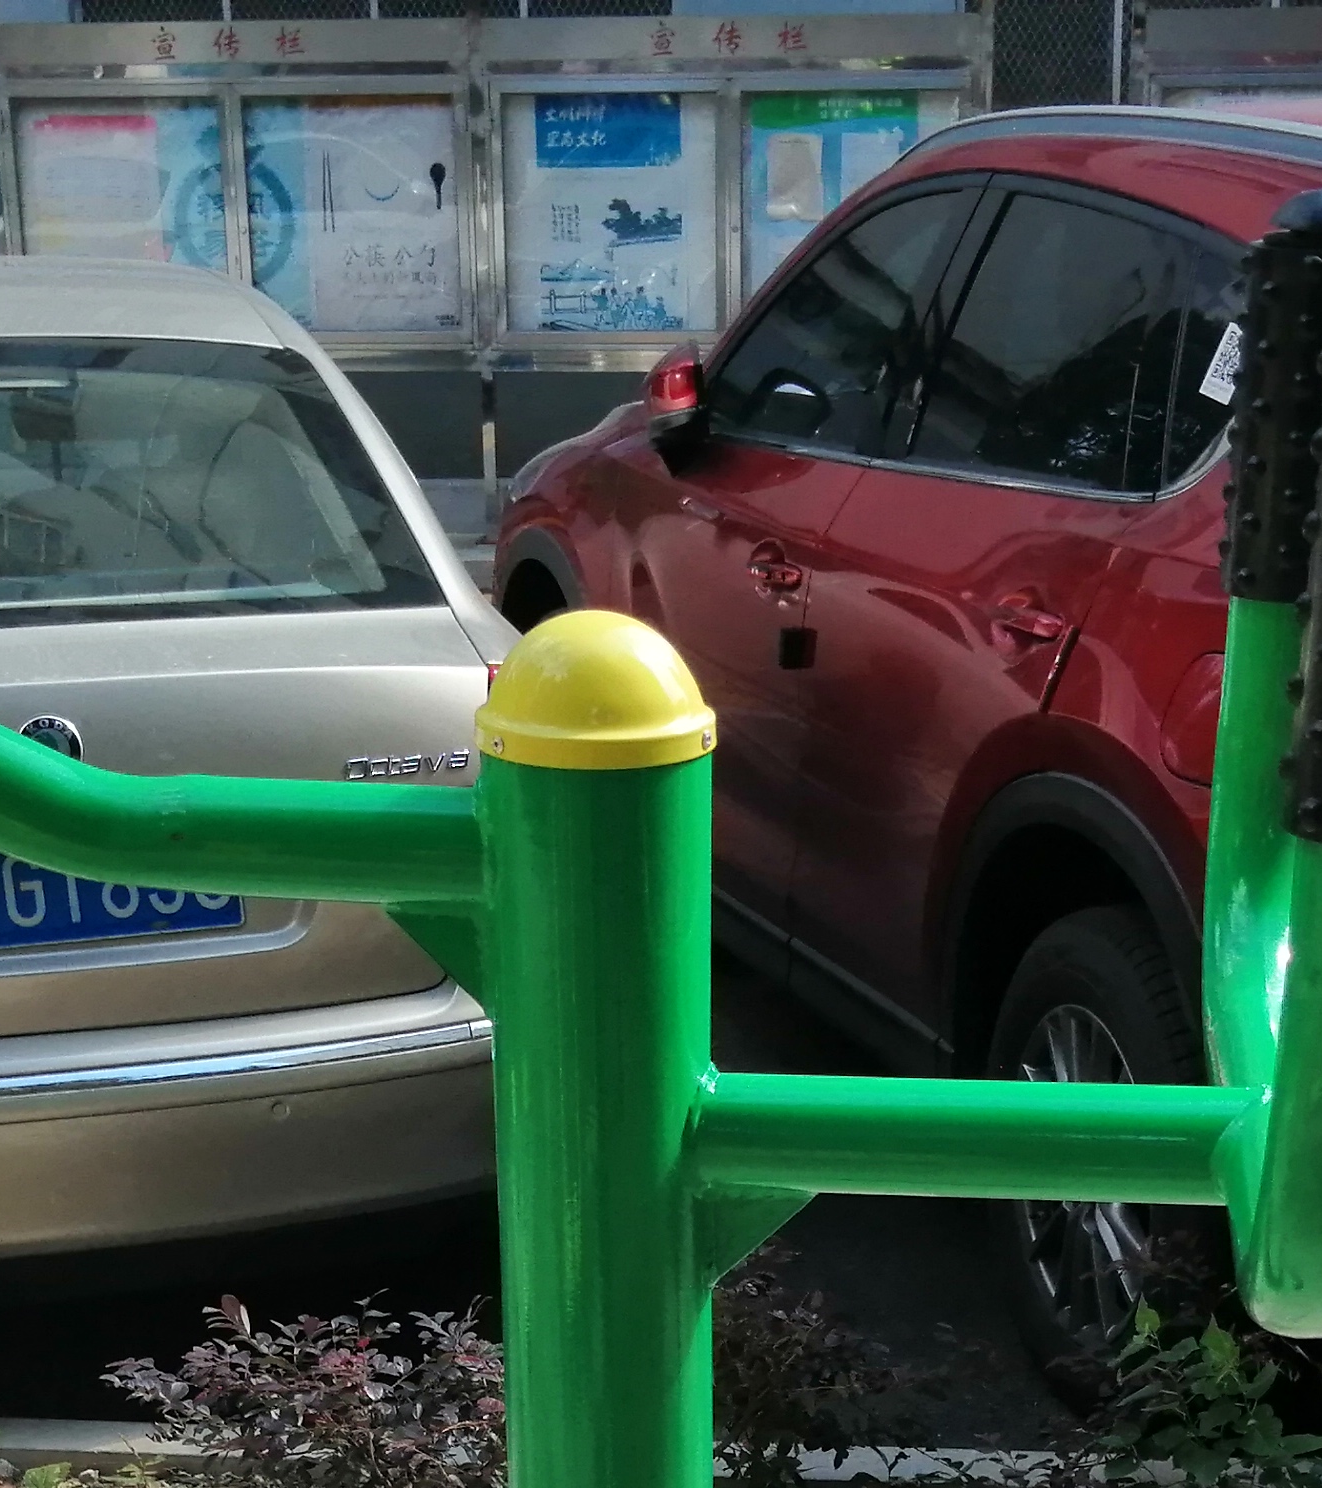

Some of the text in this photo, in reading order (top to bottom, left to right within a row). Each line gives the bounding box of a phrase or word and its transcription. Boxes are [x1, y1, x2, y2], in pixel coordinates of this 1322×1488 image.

[151, 26, 306, 60] 宣传栏
[651, 20, 807, 56] 宣传栏
